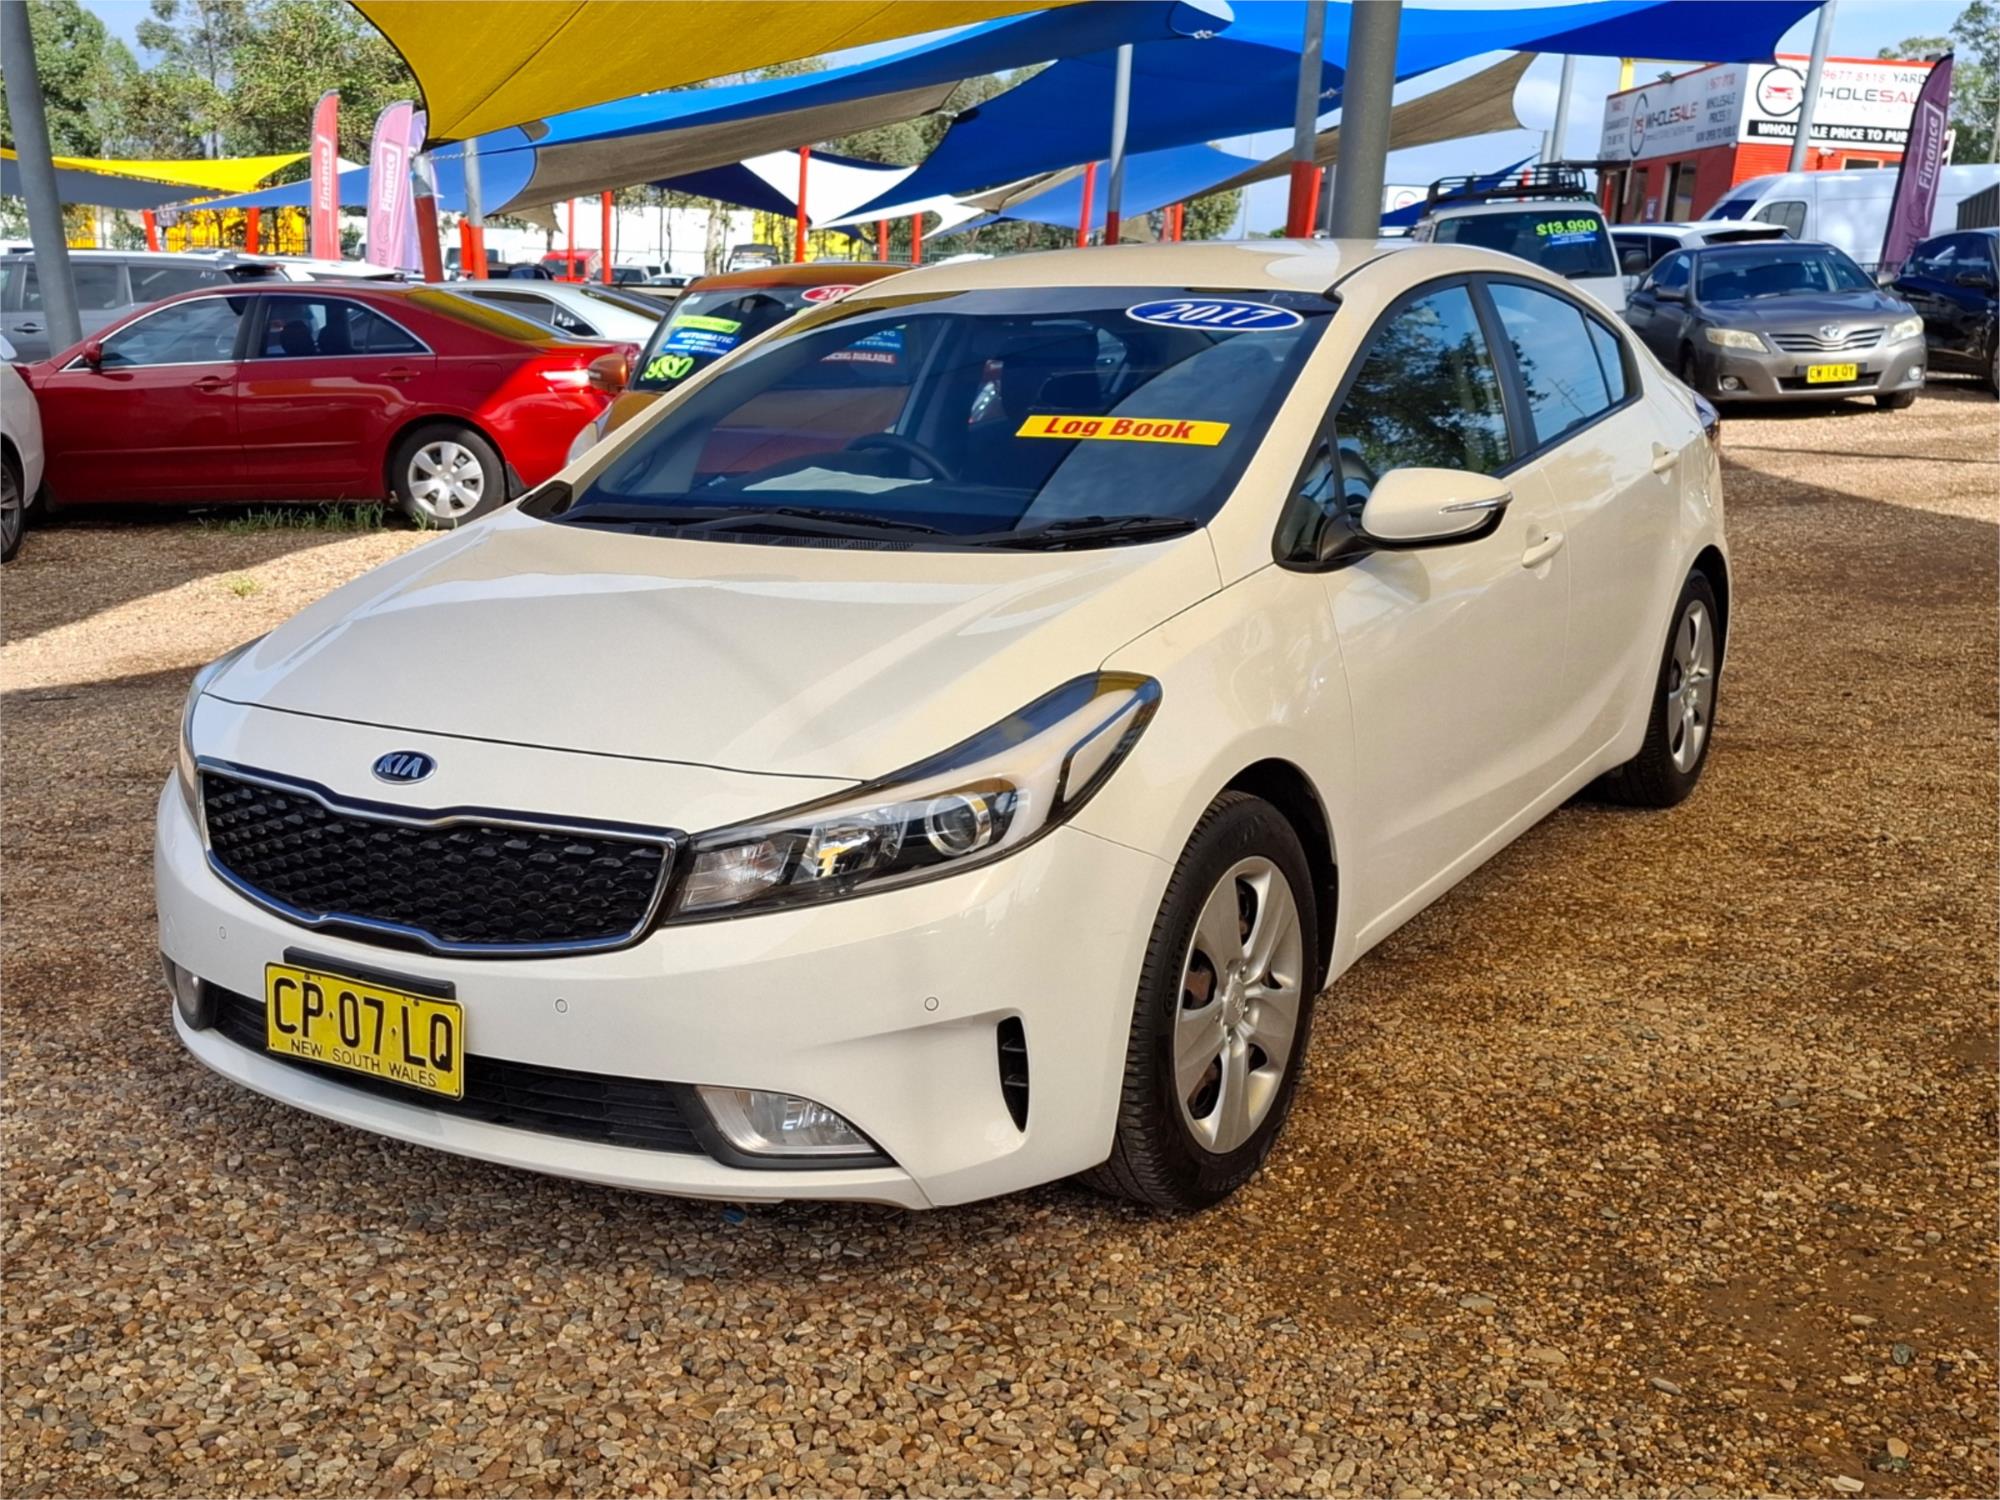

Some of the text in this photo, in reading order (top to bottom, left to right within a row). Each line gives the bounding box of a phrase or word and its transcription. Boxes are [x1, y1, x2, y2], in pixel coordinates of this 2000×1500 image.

[1819, 86, 1917, 105] HOLESAL
[1645, 101, 1699, 129] WHOLESALE
[1830, 127, 1865, 140] PRICE
[1867, 129, 1883, 141] TO
[1884, 130, 1908, 143] PUB
[1918, 116, 1939, 190] Finance
[320, 147, 332, 211] Finance
[382, 152, 396, 211] Finance
[1146, 303, 1284, 325] 2017
[1044, 417, 1196, 439] Log Book
[377, 754, 423, 778] KIA
[291, 1039, 436, 1087] NEW SOUTH WALES
